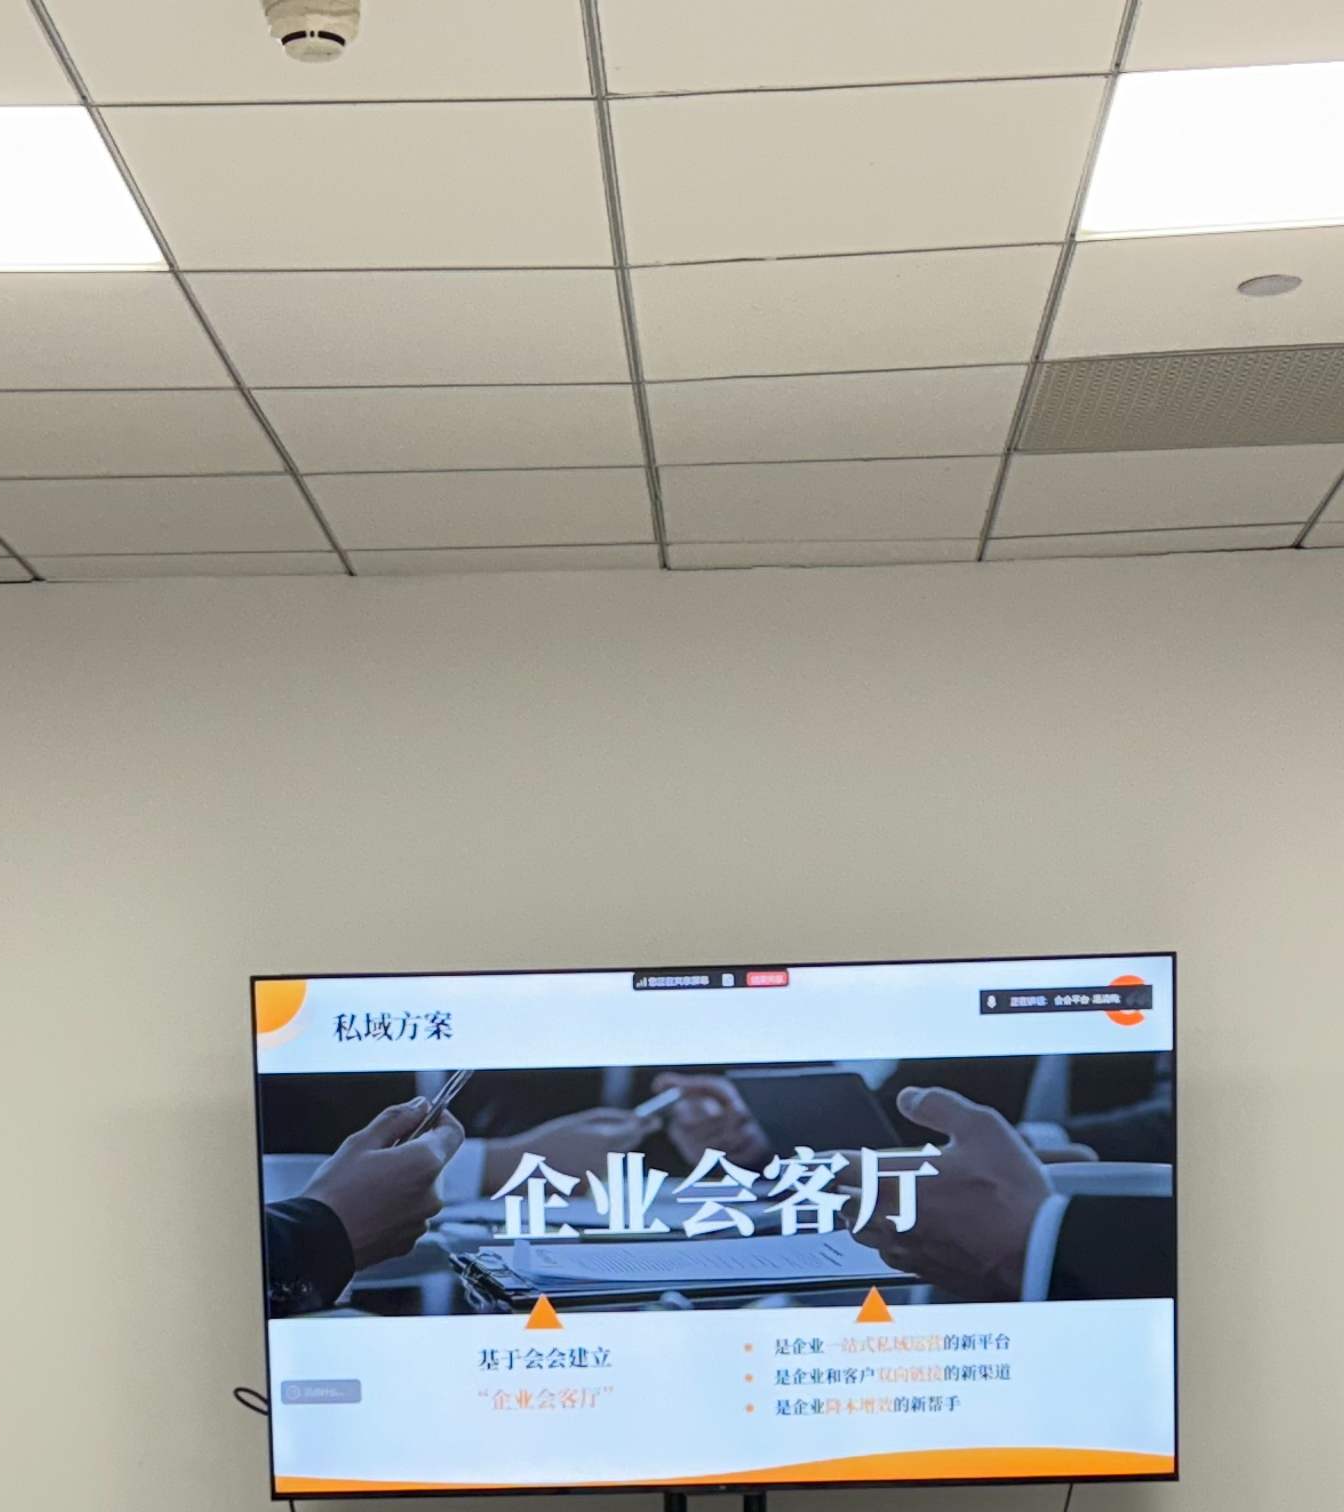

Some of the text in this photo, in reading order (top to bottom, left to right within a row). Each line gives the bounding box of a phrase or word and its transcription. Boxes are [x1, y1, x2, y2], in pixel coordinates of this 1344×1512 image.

[333, 1010, 454, 1042] 私域方案
[490, 1142, 943, 1240] 企业会客厅
[478, 1346, 613, 1371] 基于会会建立
